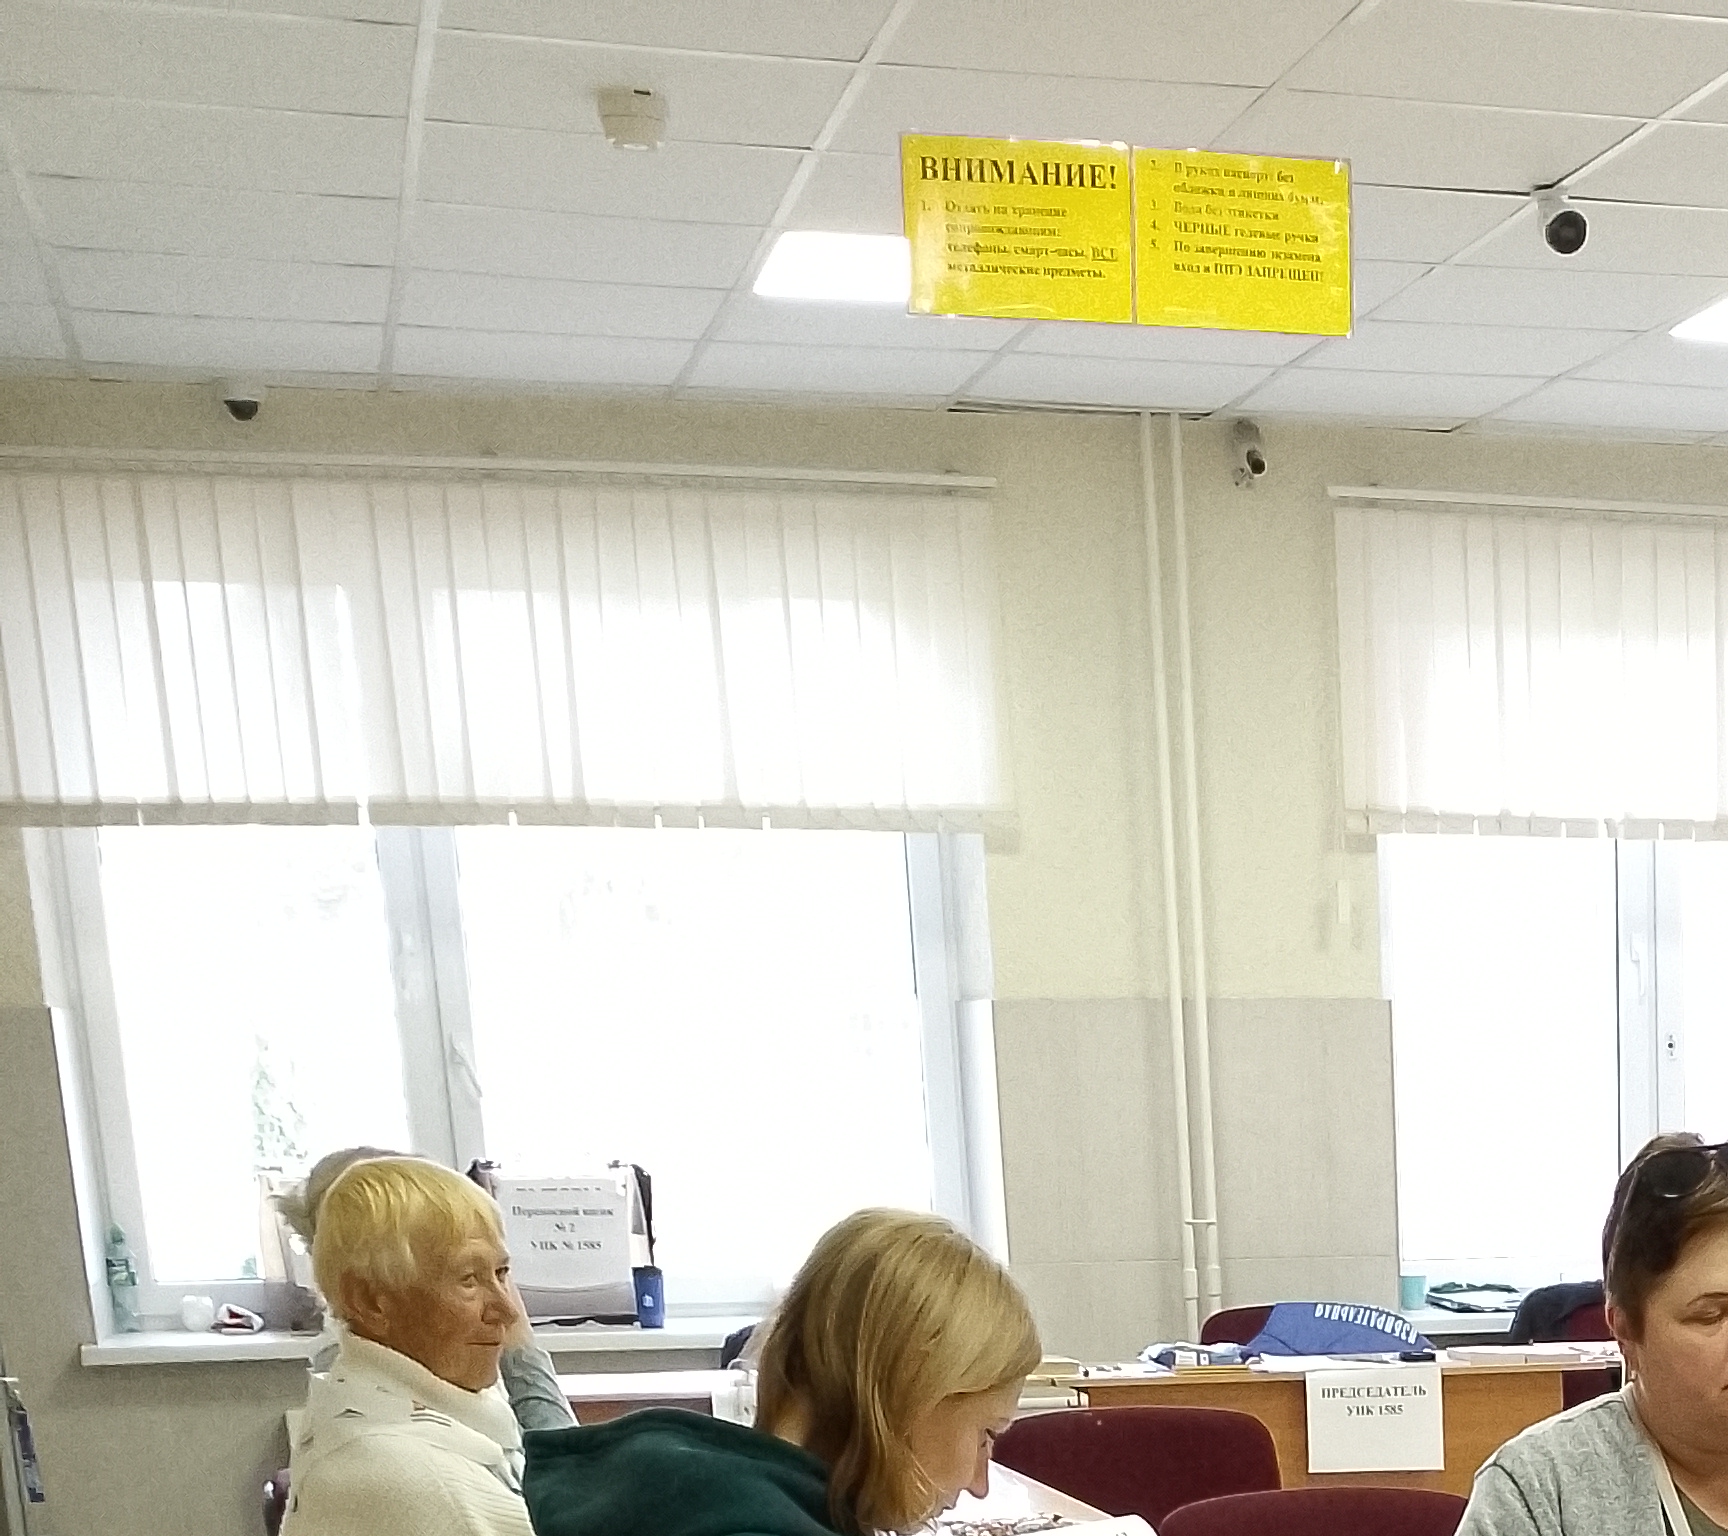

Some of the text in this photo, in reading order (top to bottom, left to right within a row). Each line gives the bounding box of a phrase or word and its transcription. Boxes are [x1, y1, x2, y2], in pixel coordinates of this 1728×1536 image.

[920, 156, 1117, 189] ВНИМАНИЕ!
[993, 204, 1007, 215] на
[1174, 240, 1190, 252] По
[569, 1222, 576, 1232] 2
[1321, 1385, 1427, 1399] ПРЕДСЕДАТЕЛЬ
[1346, 1404, 1404, 1417] УИК 1585
